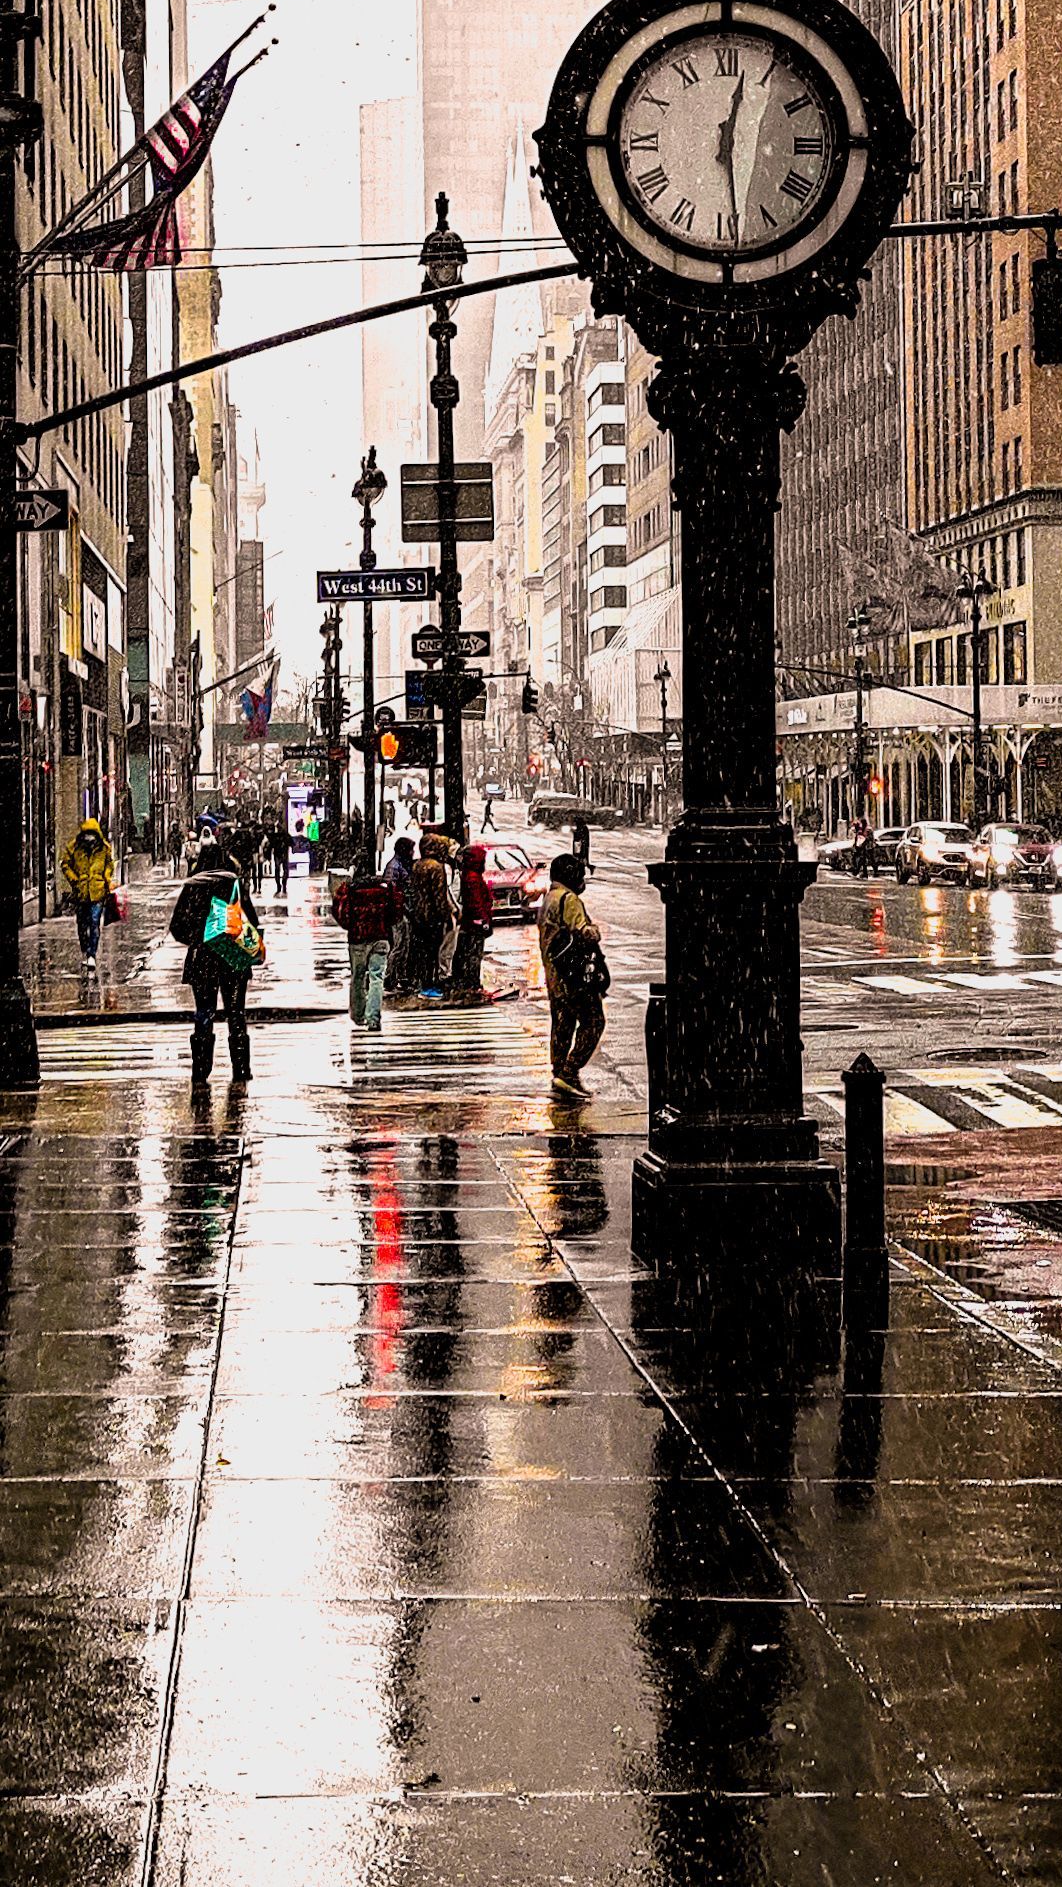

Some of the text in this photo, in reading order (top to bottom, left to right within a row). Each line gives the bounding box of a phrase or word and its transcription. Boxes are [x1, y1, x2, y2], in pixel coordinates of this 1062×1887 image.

[670, 57, 701, 89] XI
[714, 48, 739, 77] XII
[755, 59, 778, 87] I
[640, 88, 670, 115] X
[783, 92, 814, 118] II
[630, 130, 659, 151] IX
[794, 137, 825, 156] III
[637, 165, 671, 202] VIII
[669, 198, 697, 231] VII
[759, 205, 778, 227] V
[323, 576, 423, 595] West 44th St
[419, 640, 443, 650] ONE
